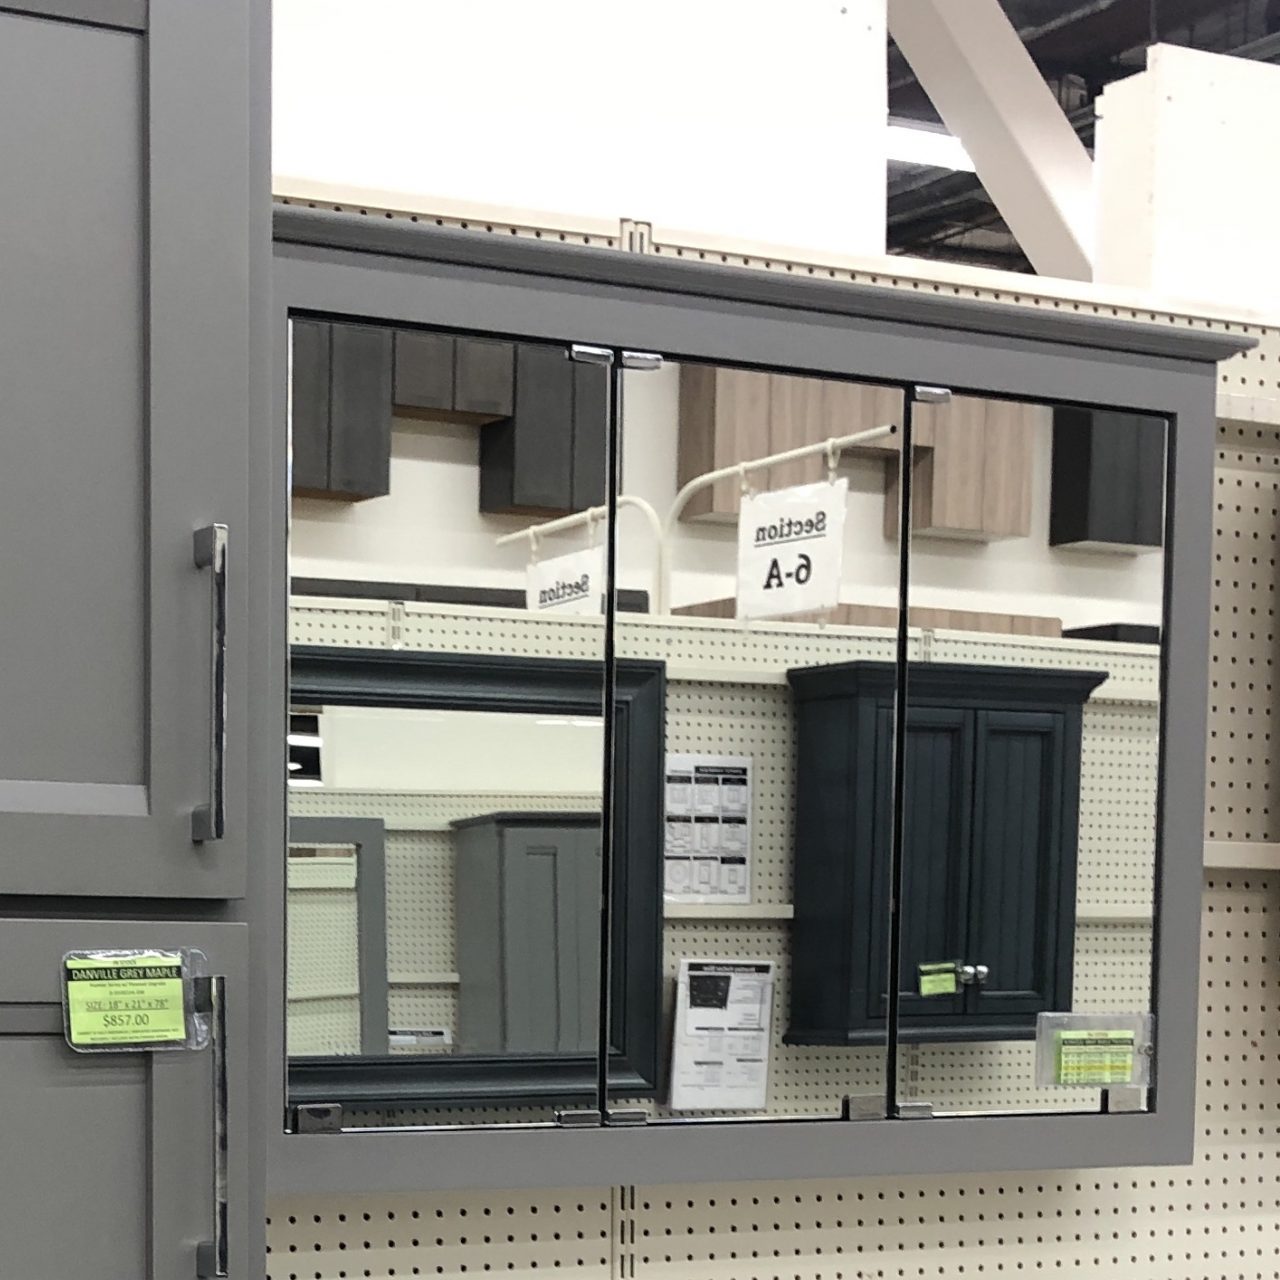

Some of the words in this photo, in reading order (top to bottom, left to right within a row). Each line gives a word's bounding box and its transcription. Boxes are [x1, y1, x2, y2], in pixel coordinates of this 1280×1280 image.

[72, 968, 118, 980] DANVILLE
[120, 967, 144, 979] GREY
[145, 966, 178, 978] MAPLE
[103, 1014, 150, 1028] $857.00
